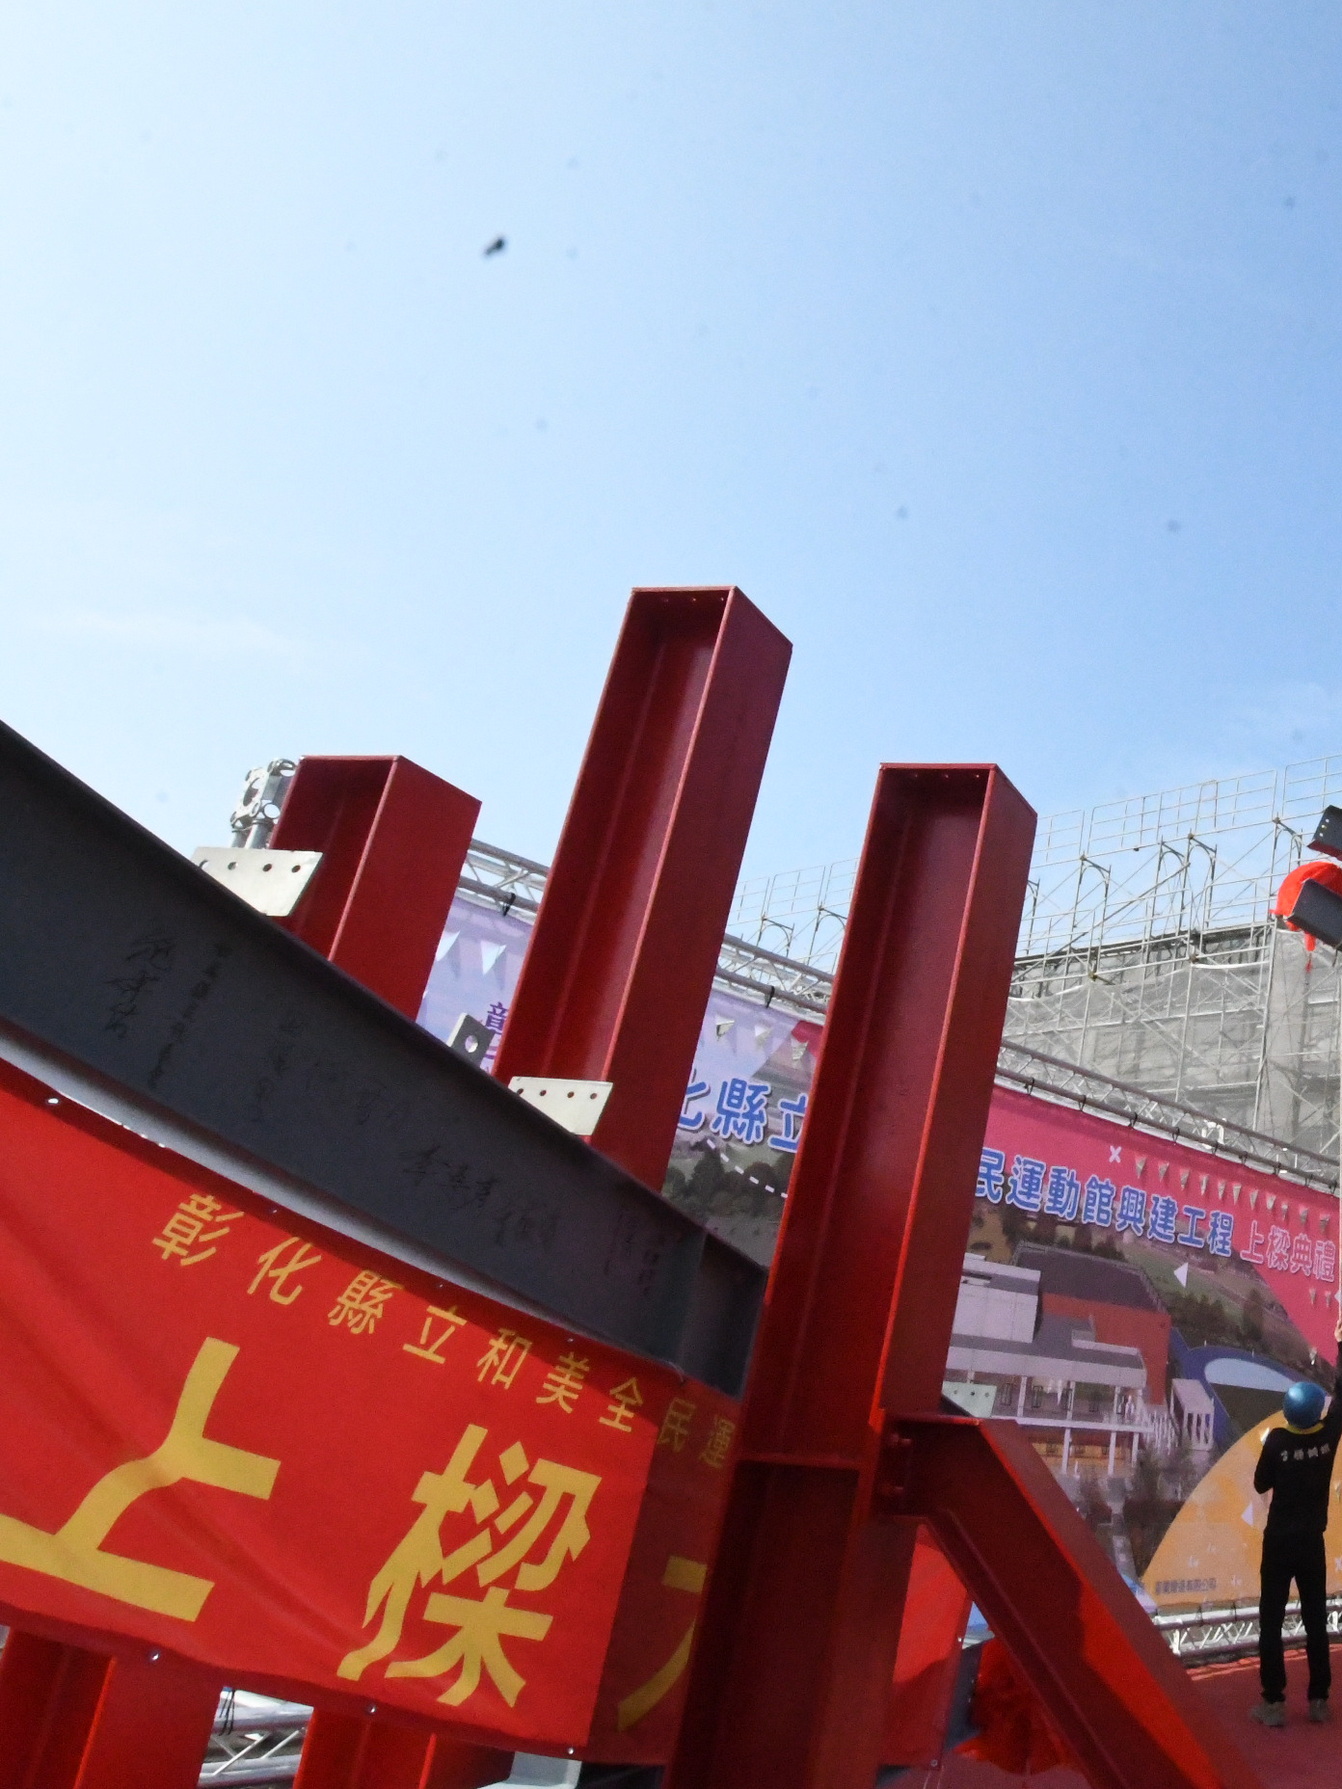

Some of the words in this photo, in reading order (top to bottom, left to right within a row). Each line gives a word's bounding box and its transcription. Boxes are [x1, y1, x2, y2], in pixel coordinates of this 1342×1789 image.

[975, 1147, 1234, 1257] 民運動館興建工程
[1240, 1219, 1336, 1284] 上樑典禮
